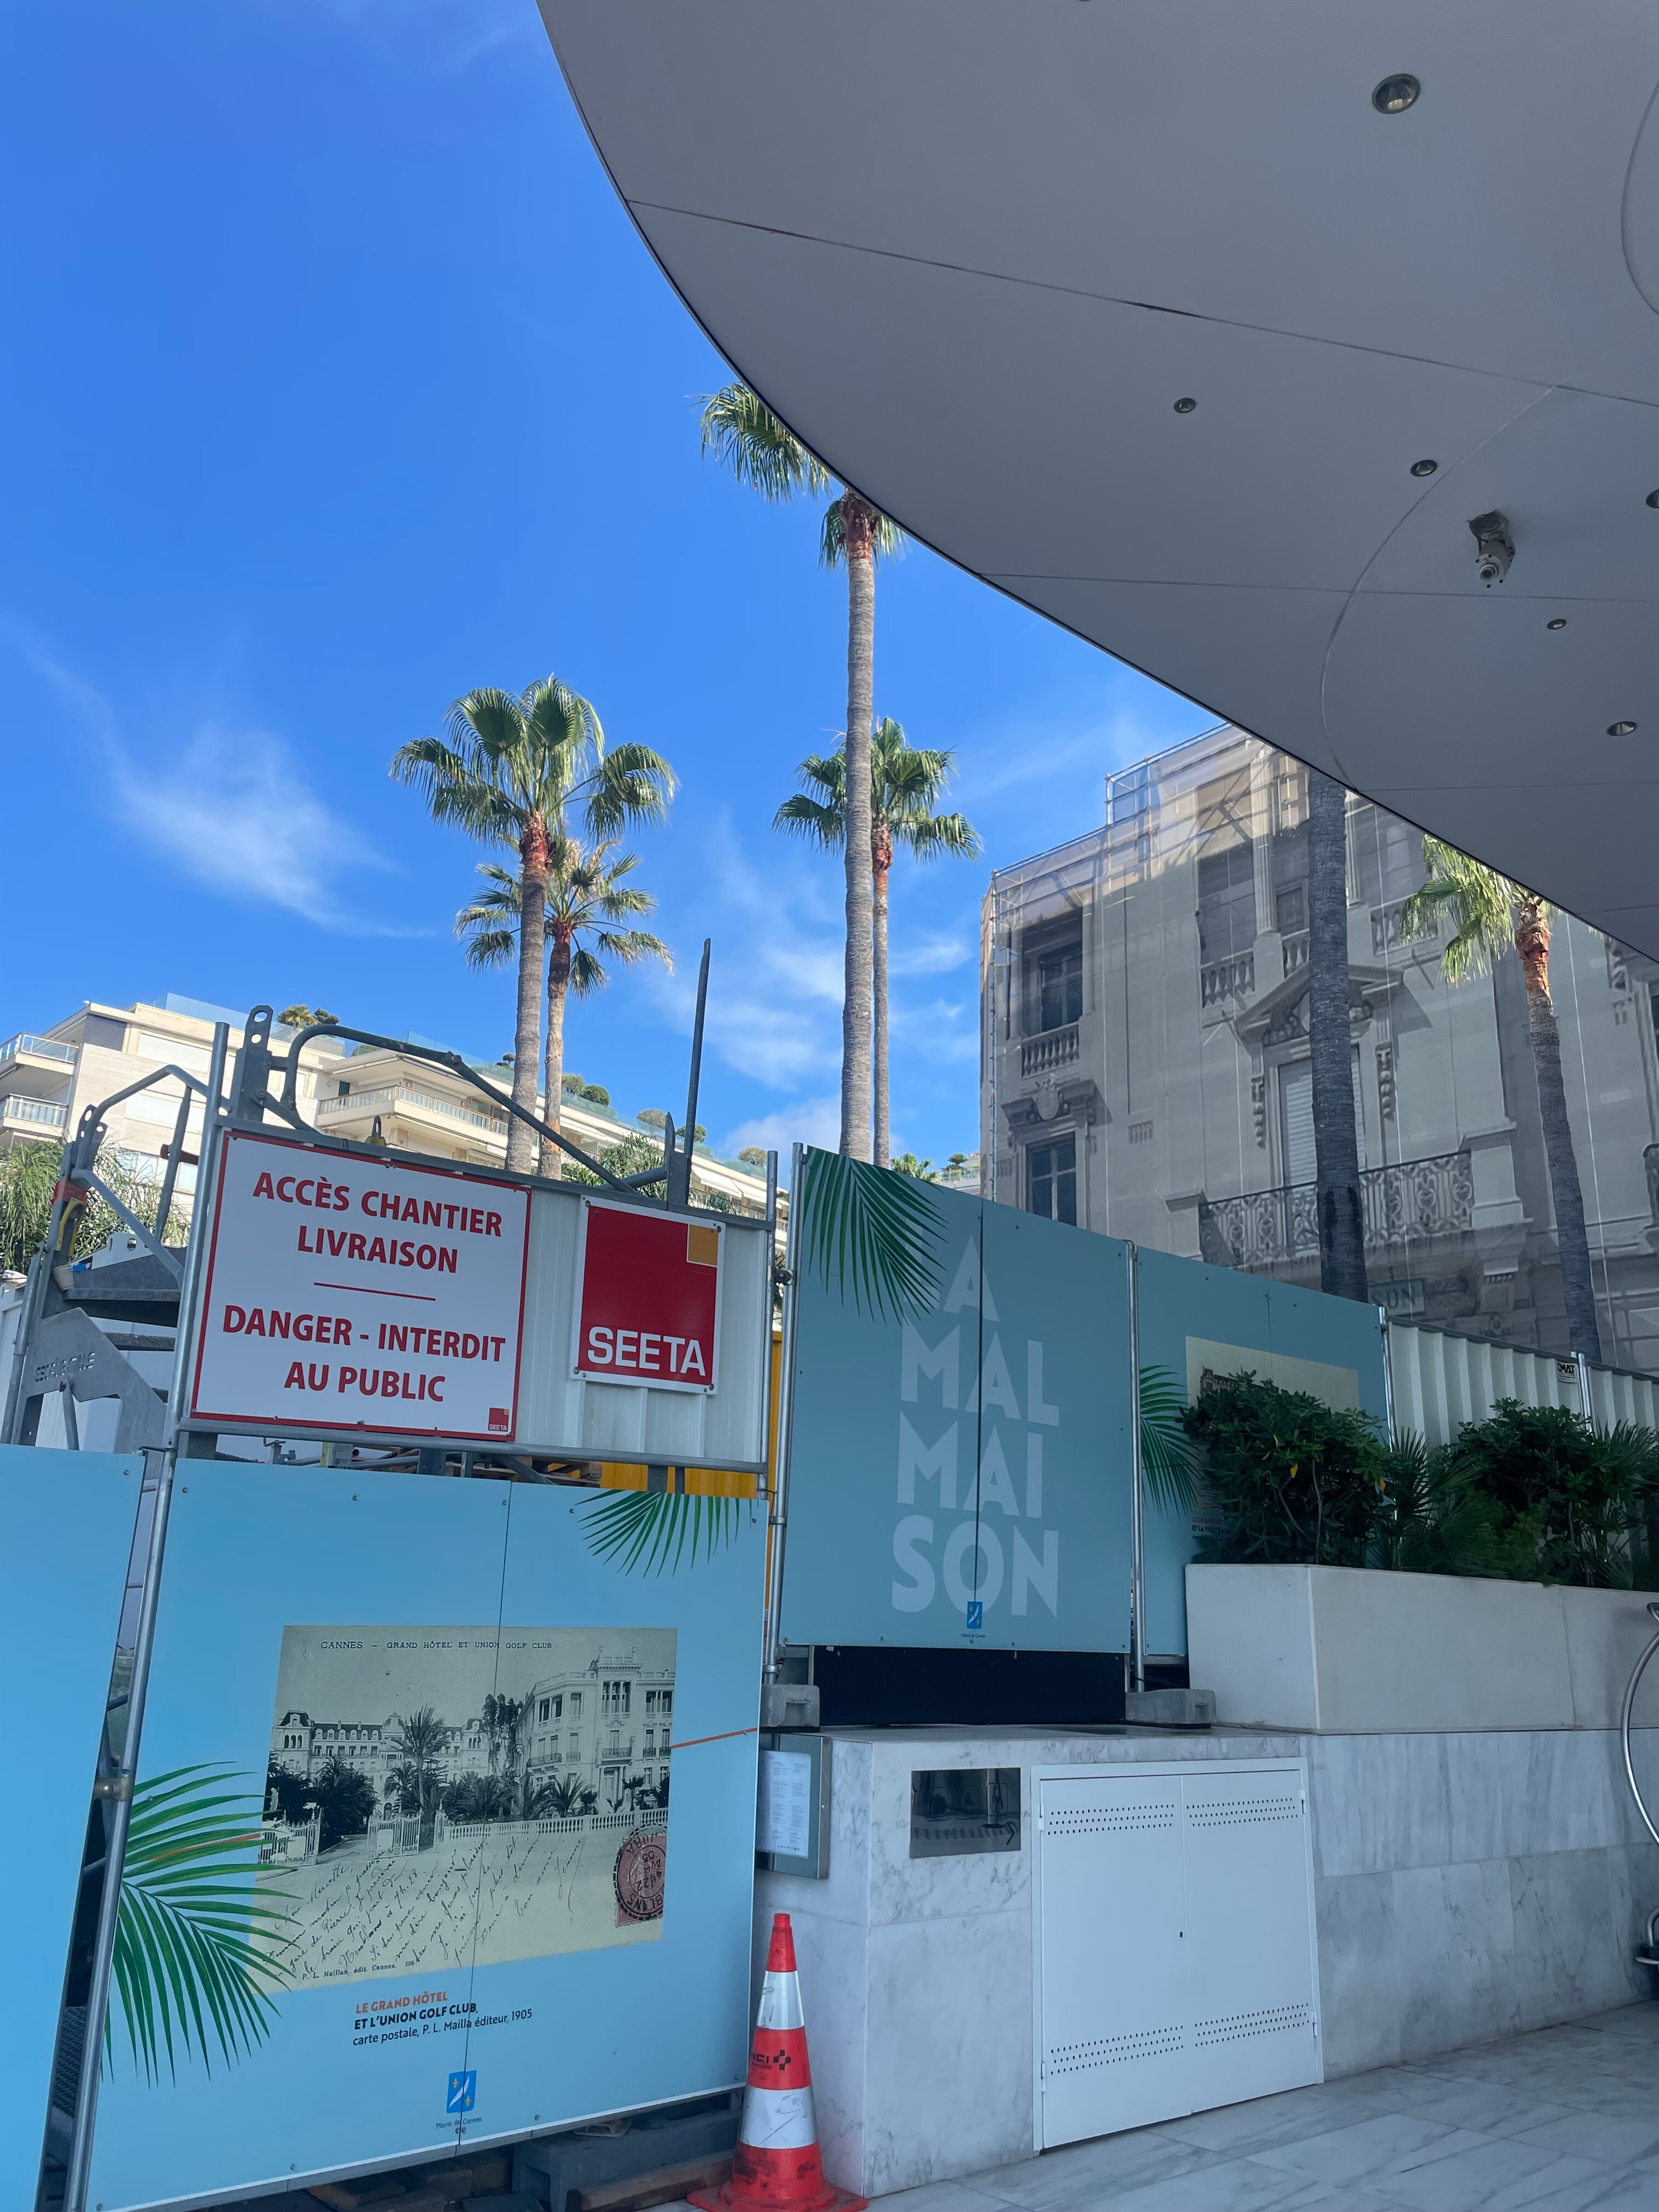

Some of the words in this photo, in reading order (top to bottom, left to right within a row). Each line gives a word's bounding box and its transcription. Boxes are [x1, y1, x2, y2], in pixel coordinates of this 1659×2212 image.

[253, 1172, 349, 1211] ACCÈS
[361, 1191, 502, 1237] CHANTIER
[297, 1226, 458, 1273] LIVRAISON
[223, 1305, 352, 1346] DANGER
[377, 1324, 506, 1362] INTERDIT
[588, 1326, 707, 1377] SEETA
[284, 1362, 330, 1391] AU
[338, 1367, 446, 1402] PUBLIC
[900, 1315, 1060, 1426] MAL
[896, 1410, 1043, 1519] MAI
[891, 1515, 1059, 1618] SON
[424, 1640, 453, 1649] HÔTEL
[354, 2018, 368, 2030] ET
[419, 2006, 448, 2019] GOLF
[449, 2002, 478, 2015] CLUB,
[356, 2002, 369, 2014] LE
[370, 1996, 410, 2012] GRAND
[413, 1990, 448, 2005] HÔTEL
[353, 2033, 379, 2046] carte
[381, 2027, 420, 2044] postale,
[422, 2024, 430, 2034] P.
[433, 2023, 441, 2033] L.
[475, 2015, 509, 2027] éditeur,
[511, 2008, 533, 2021] 1905
[435, 2121, 453, 2129] Mairie
[462, 2117, 482, 2125] Cannes
